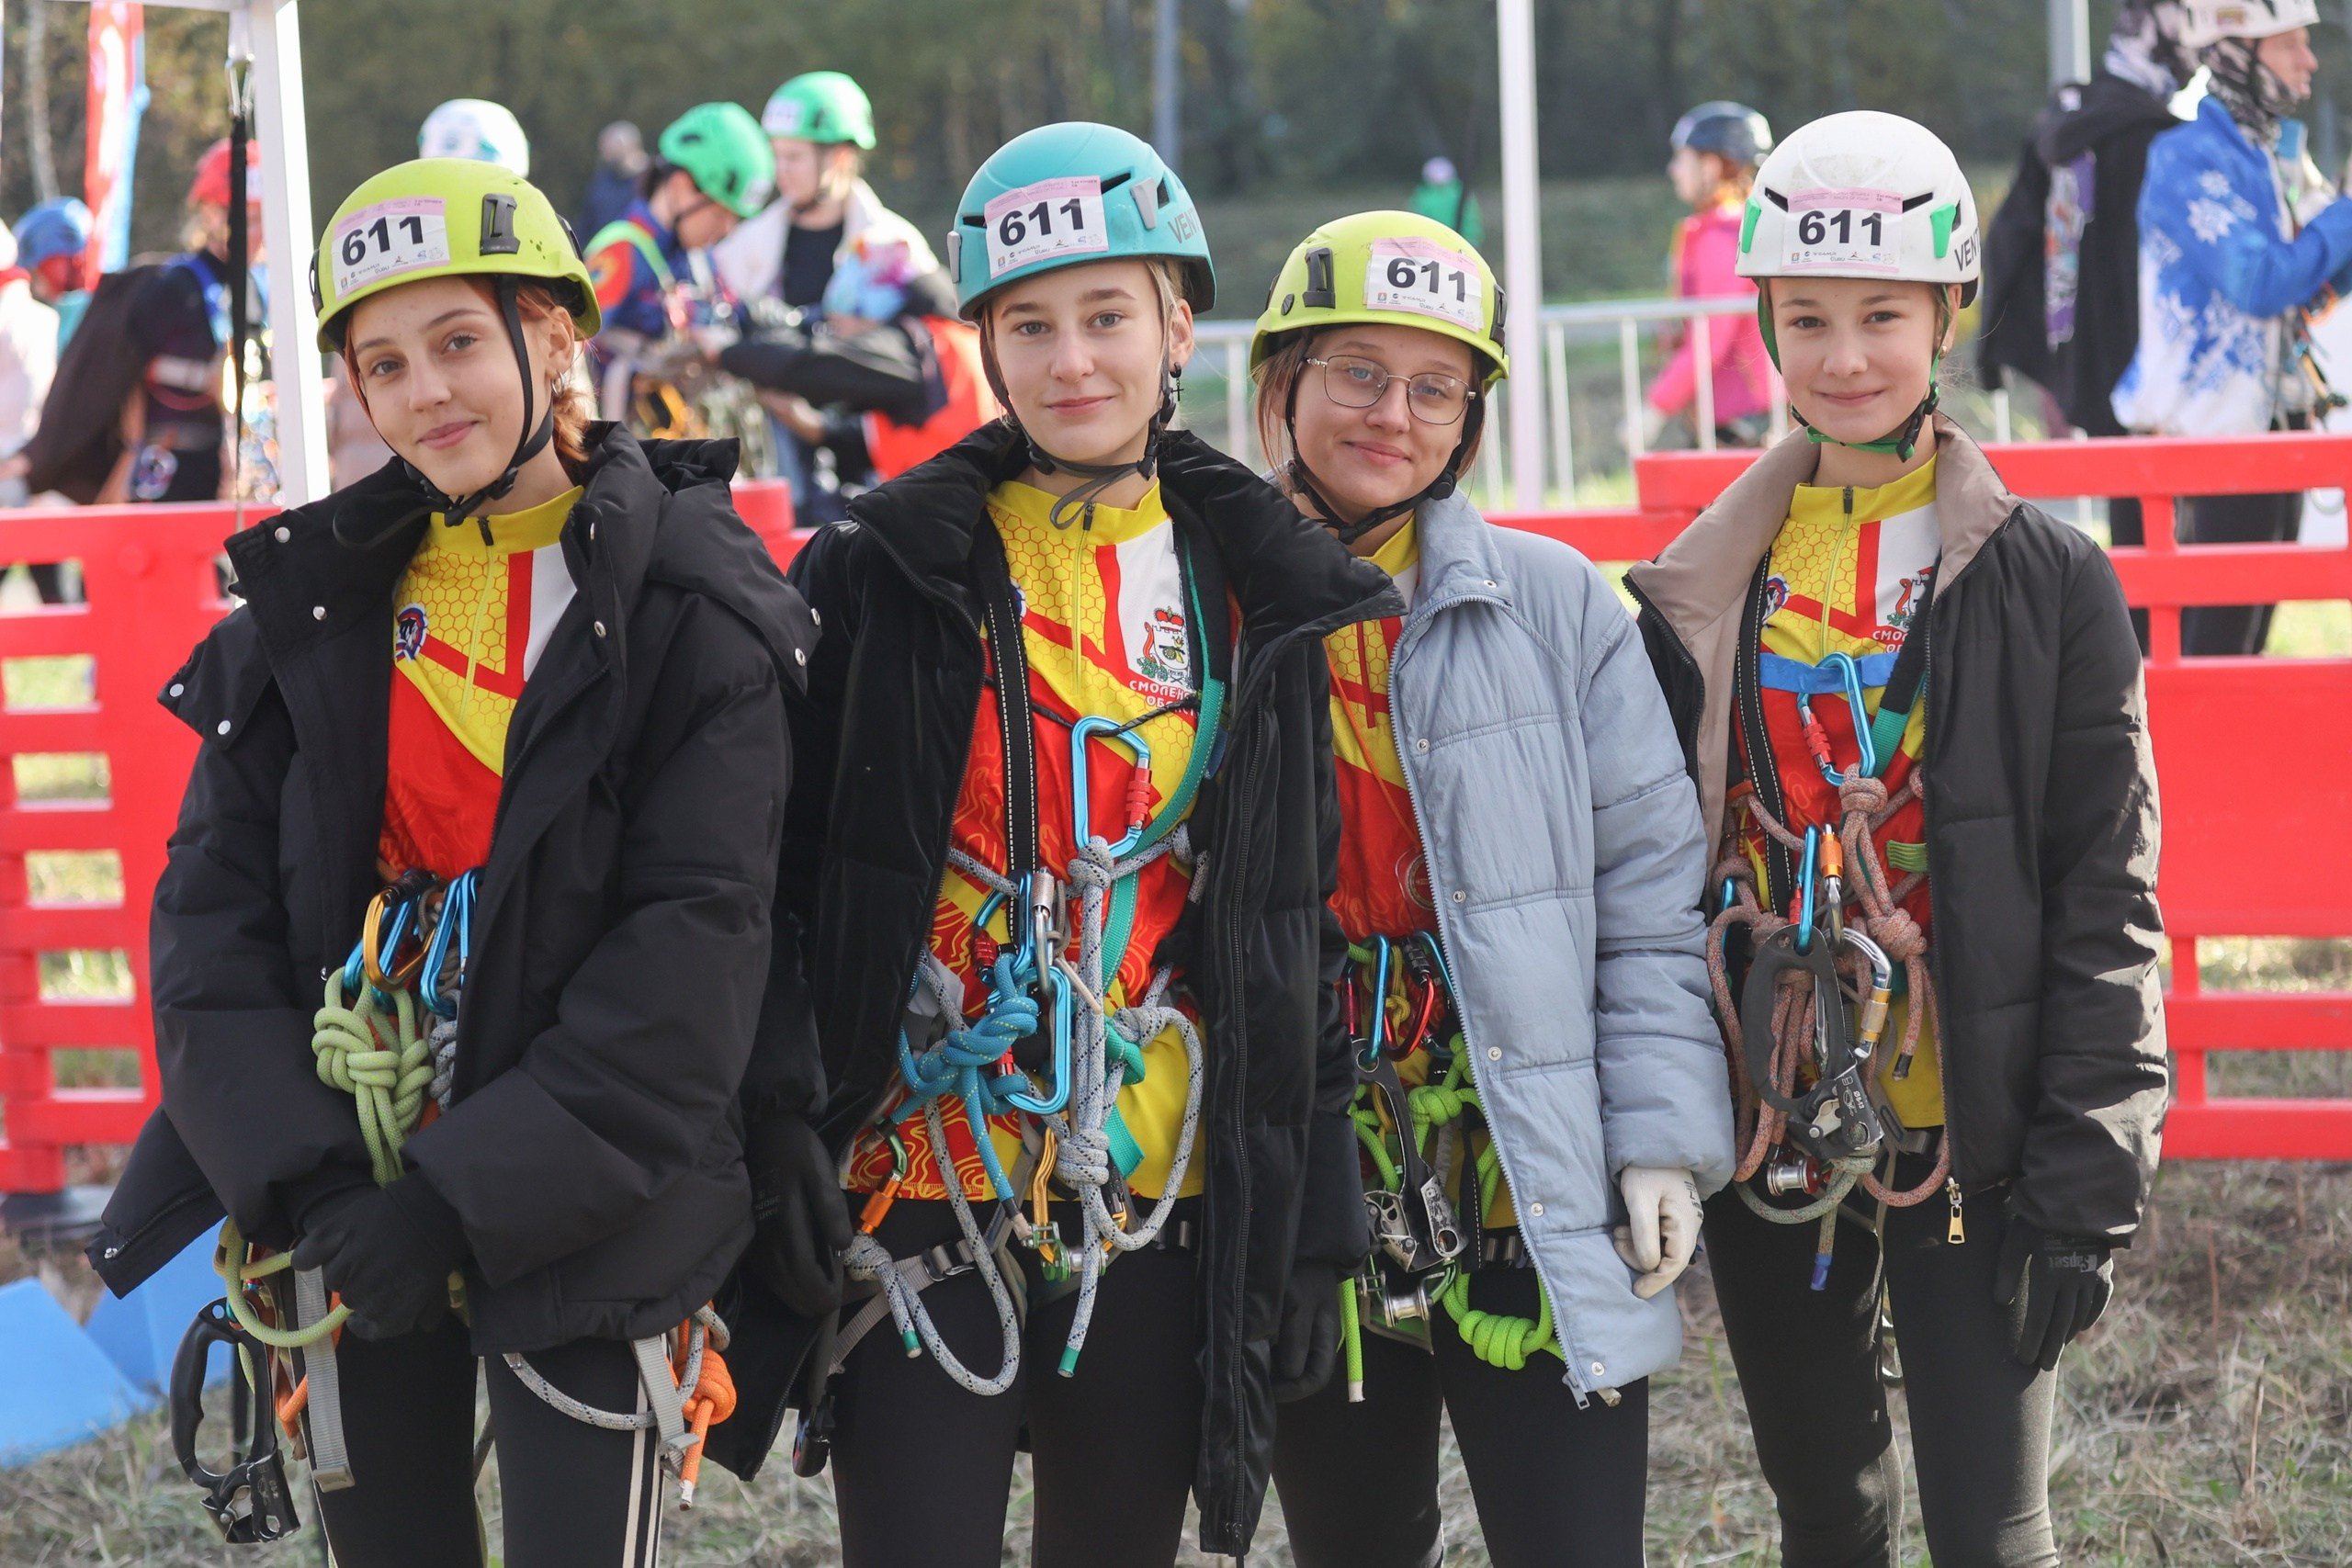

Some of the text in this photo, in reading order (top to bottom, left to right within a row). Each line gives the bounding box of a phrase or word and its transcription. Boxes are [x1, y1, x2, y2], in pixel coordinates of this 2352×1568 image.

[342, 216, 424, 266] 611
[999, 197, 1084, 246] 611
[1799, 209, 1882, 246] 611
[1387, 257, 1465, 303] 611
